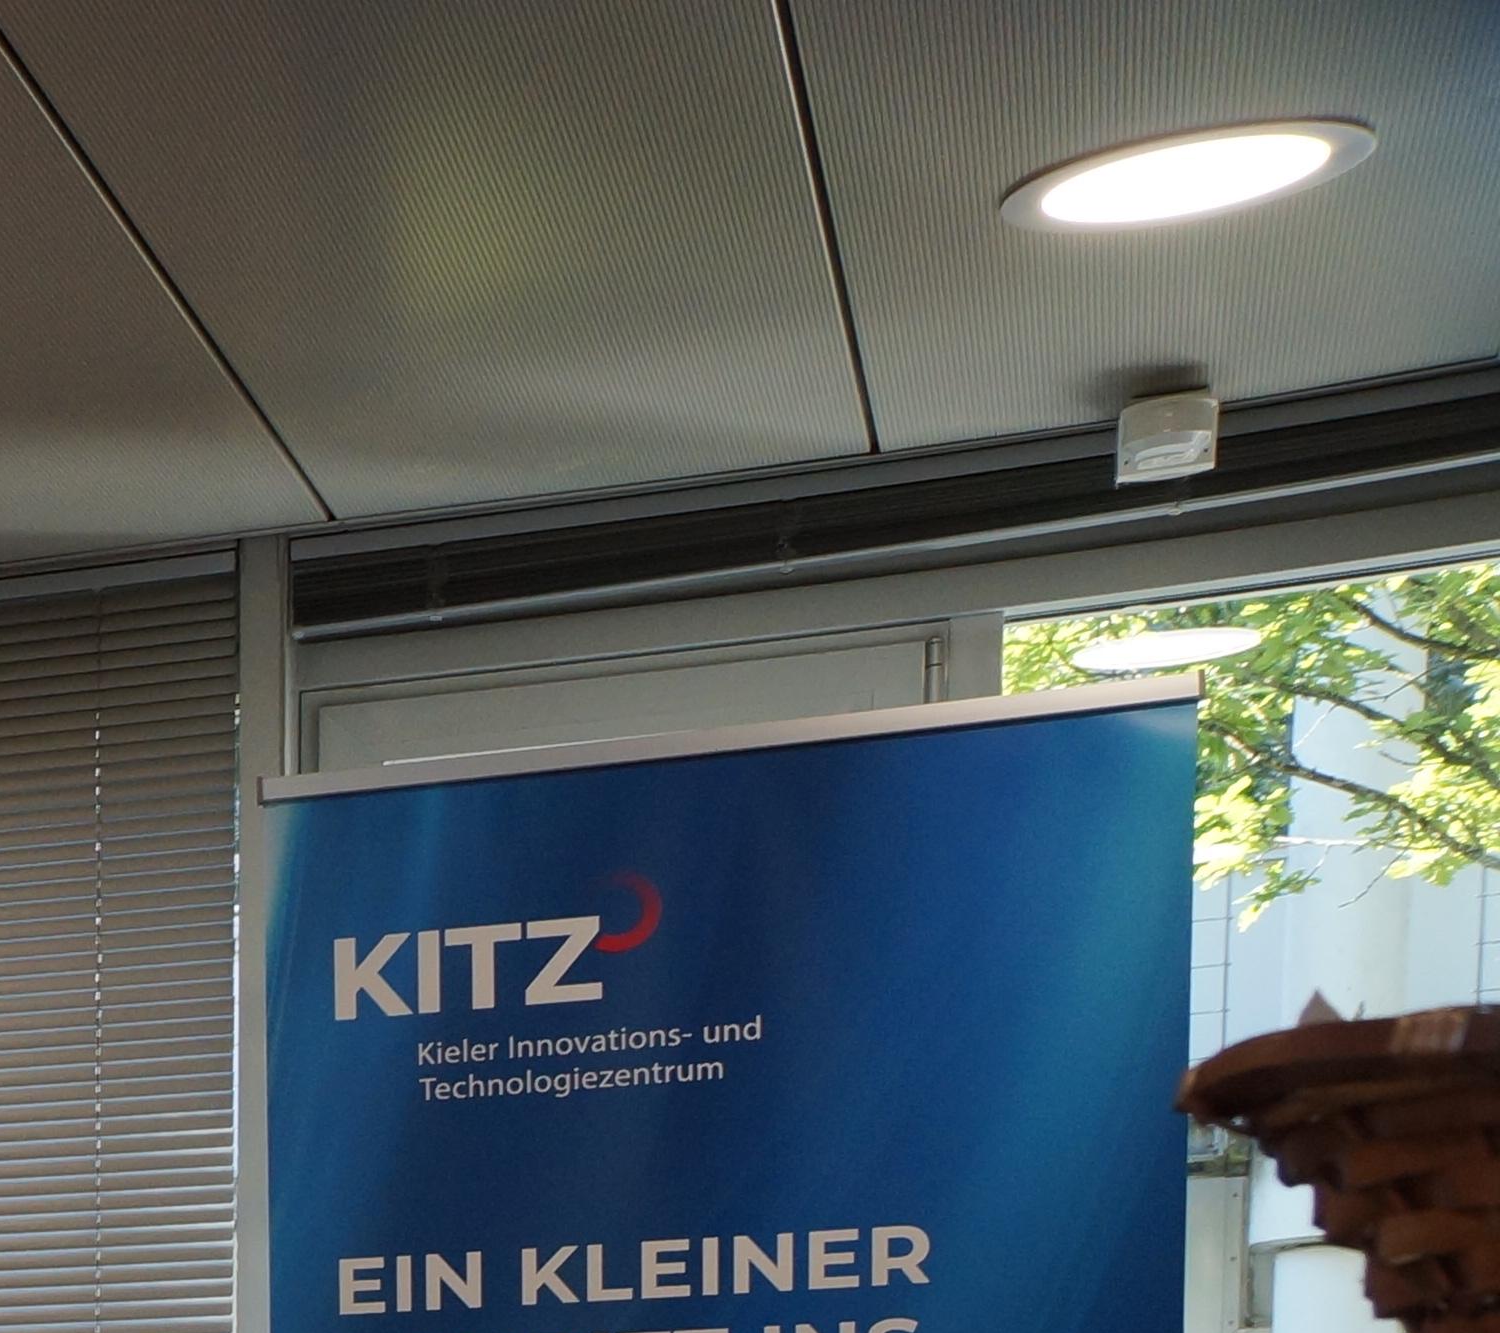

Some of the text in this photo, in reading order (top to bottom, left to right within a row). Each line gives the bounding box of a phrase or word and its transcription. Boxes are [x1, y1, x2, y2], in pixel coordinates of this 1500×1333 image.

[334, 915, 603, 1021] KITZ
[417, 1015, 762, 1067] Kieler Innovations- und
[419, 1058, 725, 1103] Technologiezentrum
[337, 1225, 930, 1317] EIN KLEINER
